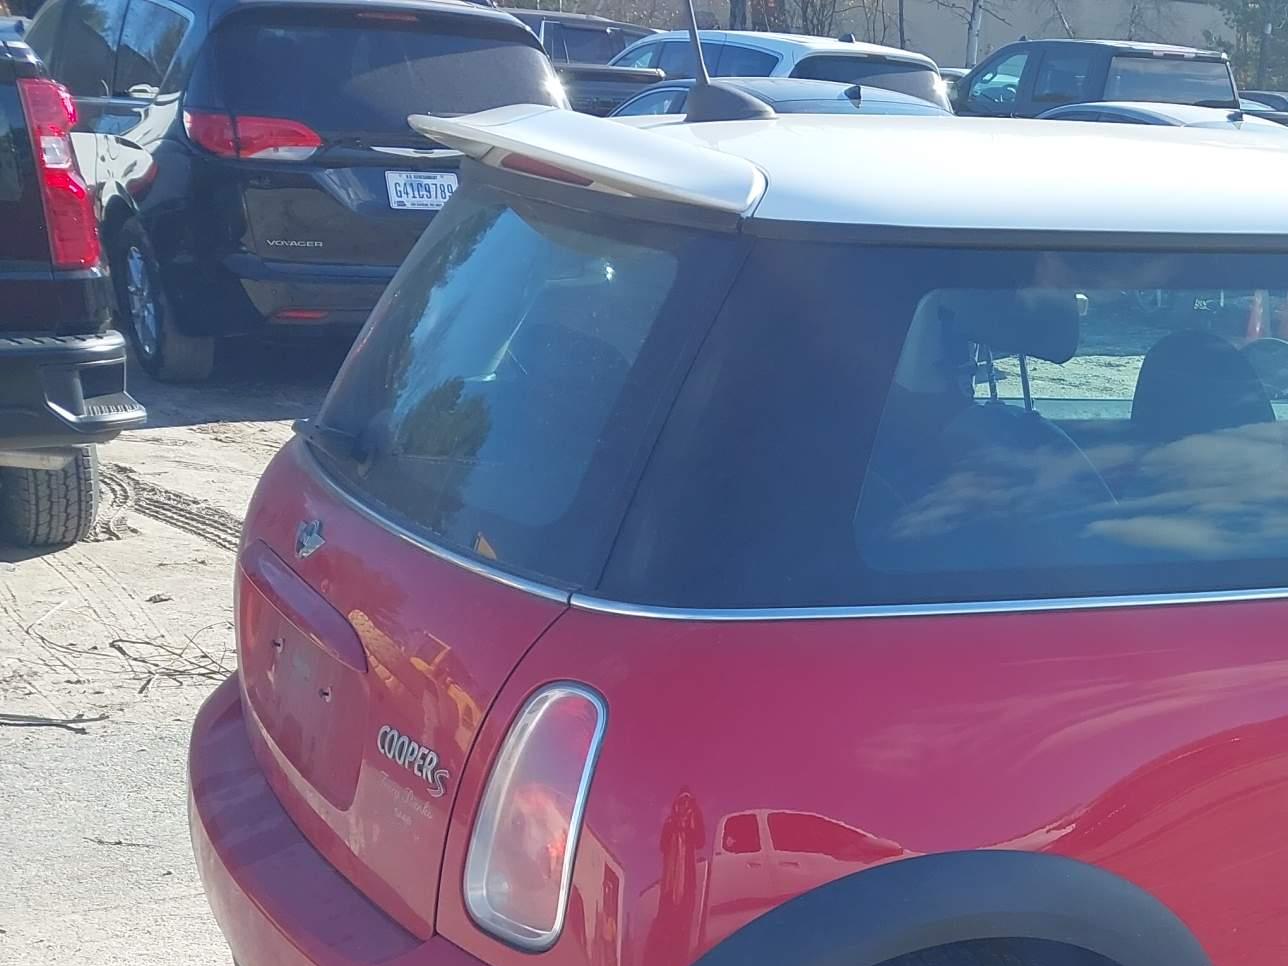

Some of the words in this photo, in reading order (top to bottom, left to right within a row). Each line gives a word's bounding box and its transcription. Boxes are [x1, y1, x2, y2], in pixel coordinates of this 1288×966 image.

[266, 239, 324, 248] VOYAGER
[376, 725, 439, 784] COOPER
[426, 769, 450, 798] S
